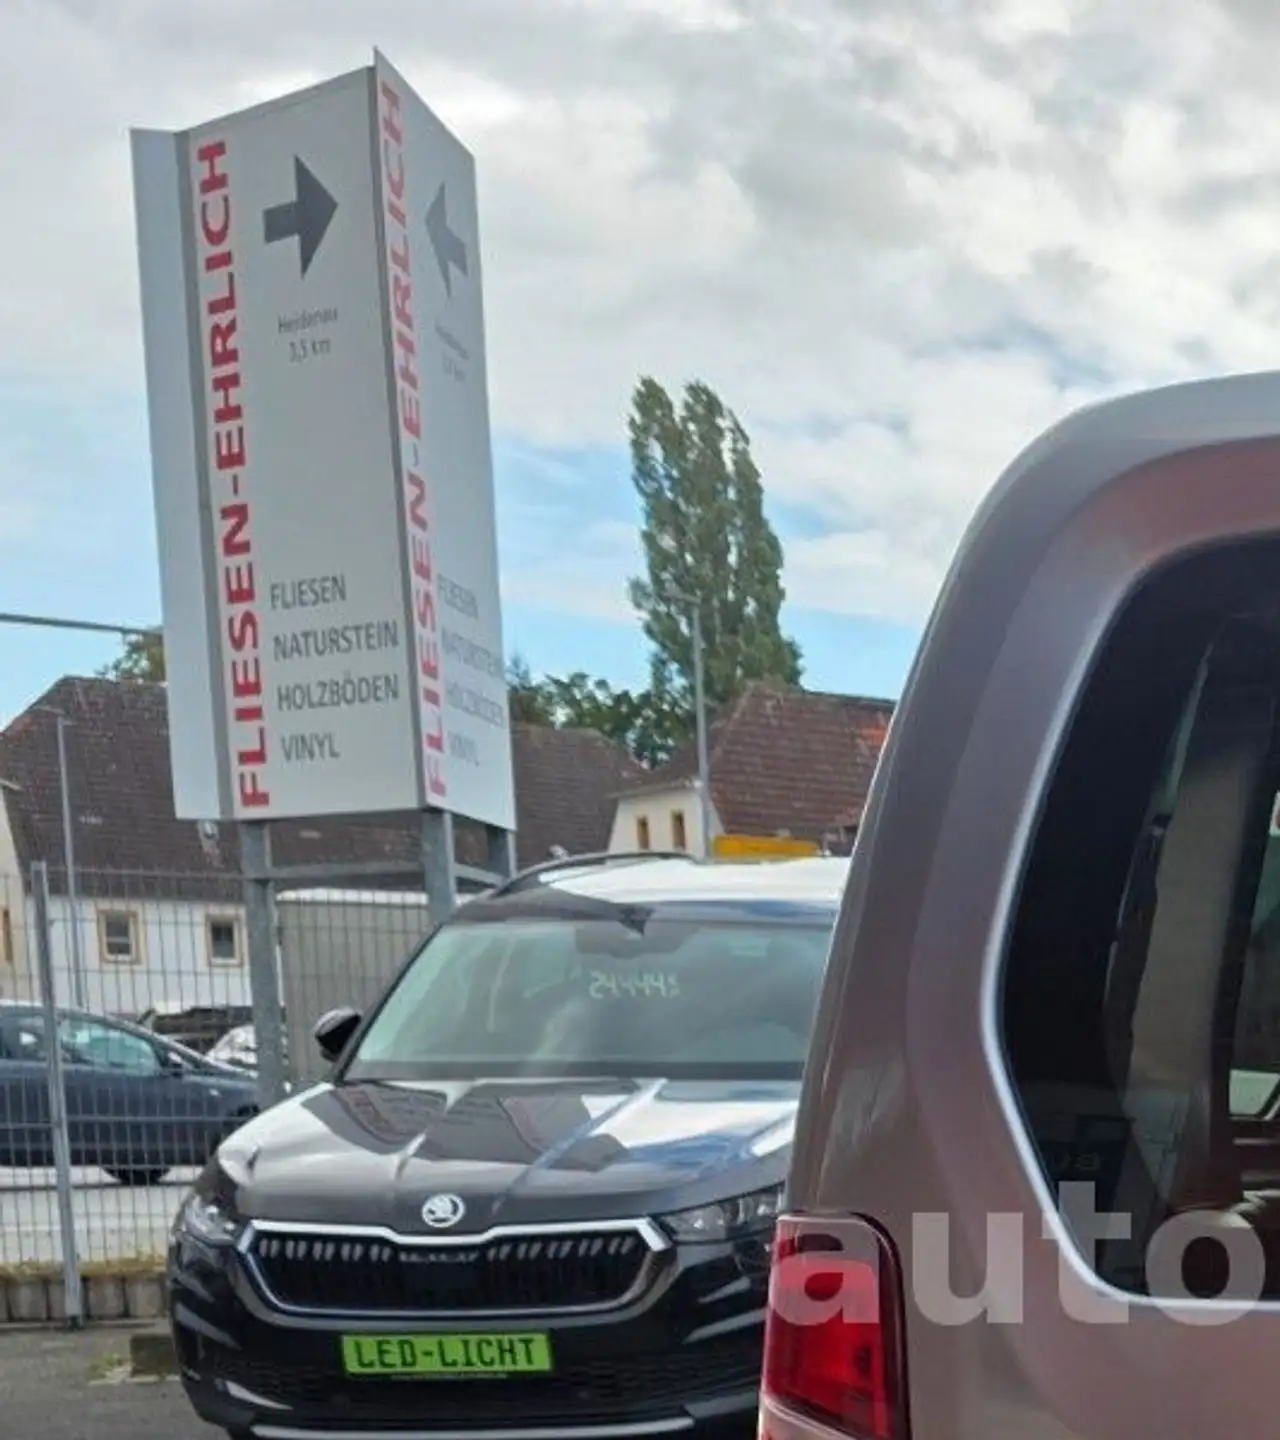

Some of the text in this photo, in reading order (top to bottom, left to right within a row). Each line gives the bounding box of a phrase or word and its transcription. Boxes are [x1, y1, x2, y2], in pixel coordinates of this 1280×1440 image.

[382, 81, 446, 798] FLIESEN-EHRLICH
[197, 140, 270, 808] FLIESEN-EHRLICH
[270, 574, 346, 610] FLIESEN
[273, 620, 398, 661] NATURSTEIN
[276, 672, 398, 711] HOLZBÖDEN
[281, 731, 340, 764] VINYL
[353, 1338, 536, 1369] LED-LICHT
